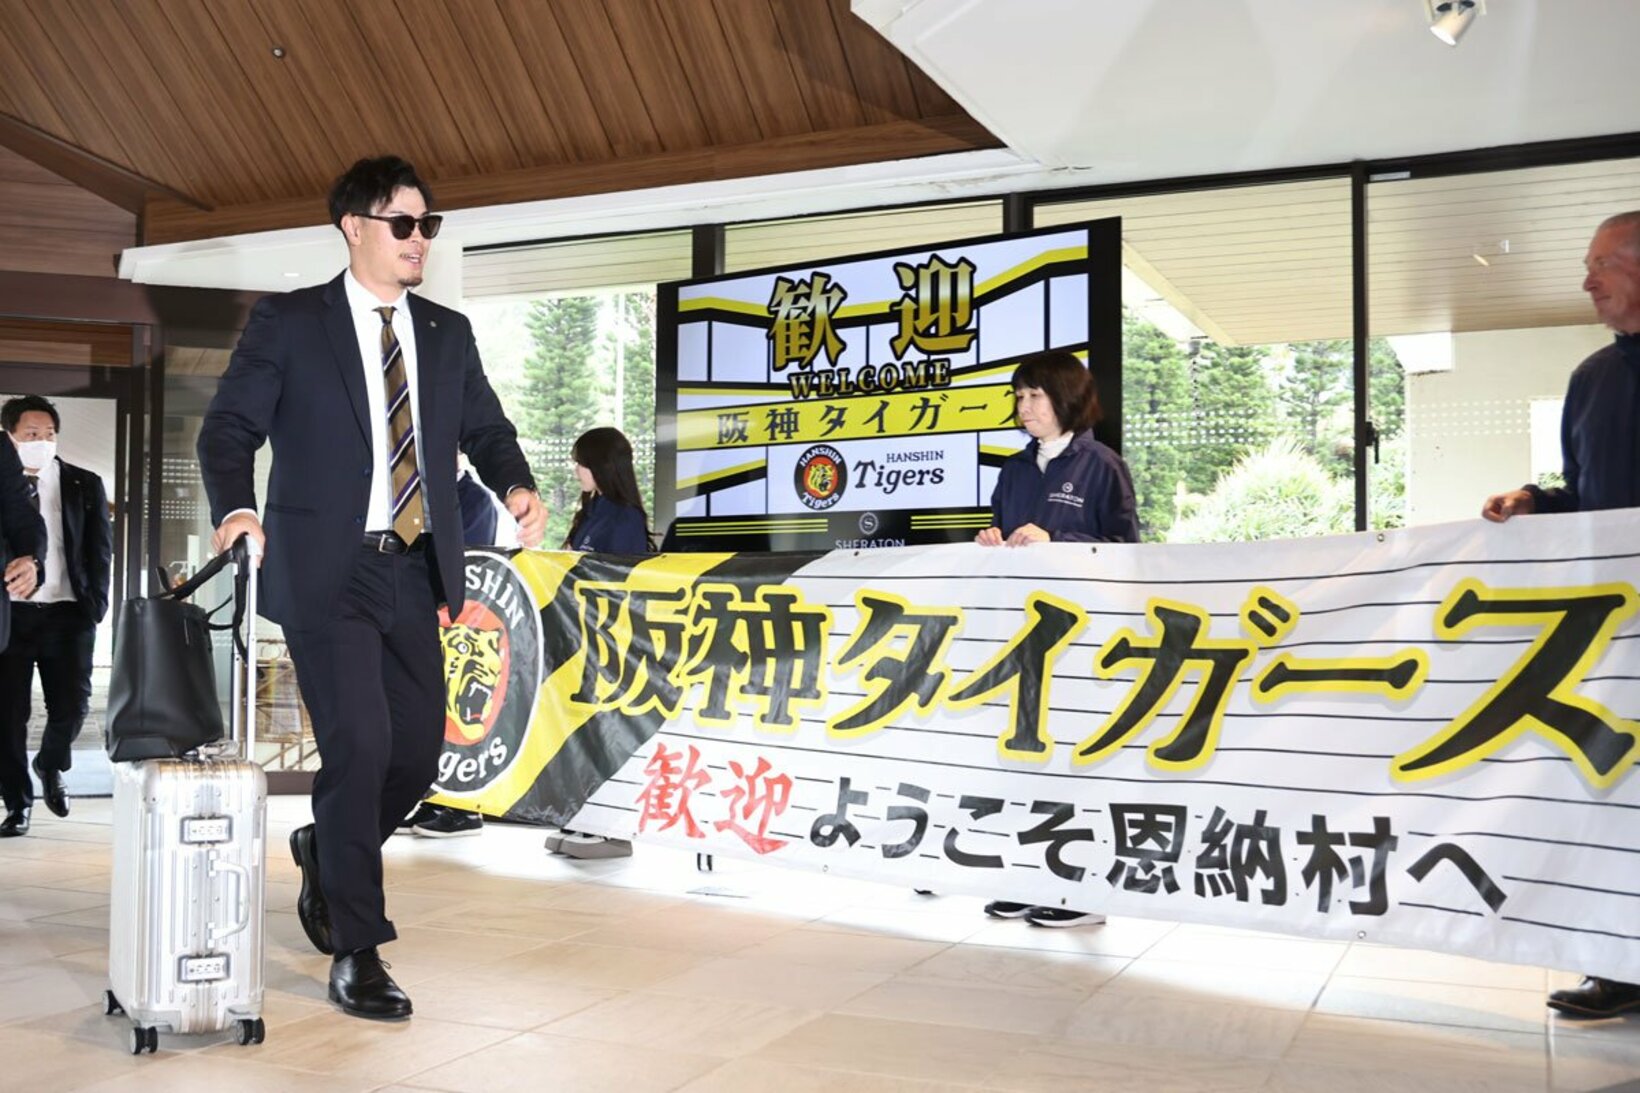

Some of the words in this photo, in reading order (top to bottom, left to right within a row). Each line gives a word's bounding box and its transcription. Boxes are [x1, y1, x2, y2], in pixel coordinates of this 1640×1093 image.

[767, 253, 977, 372] 歓迎
[789, 359, 950, 399] WELCOME
[800, 447, 841, 466] HANSHIN
[853, 460, 945, 494] Tigers
[886, 450, 944, 463] HANSHIN
[835, 538, 905, 549] SHERATON
[464, 564, 526, 630] SHIN
[567, 583, 1638, 780] 阪神タイガース
[437, 737, 508, 782] gers
[634, 740, 792, 854] 歓迎
[809, 776, 1508, 916] ようこそ恩納村へ
